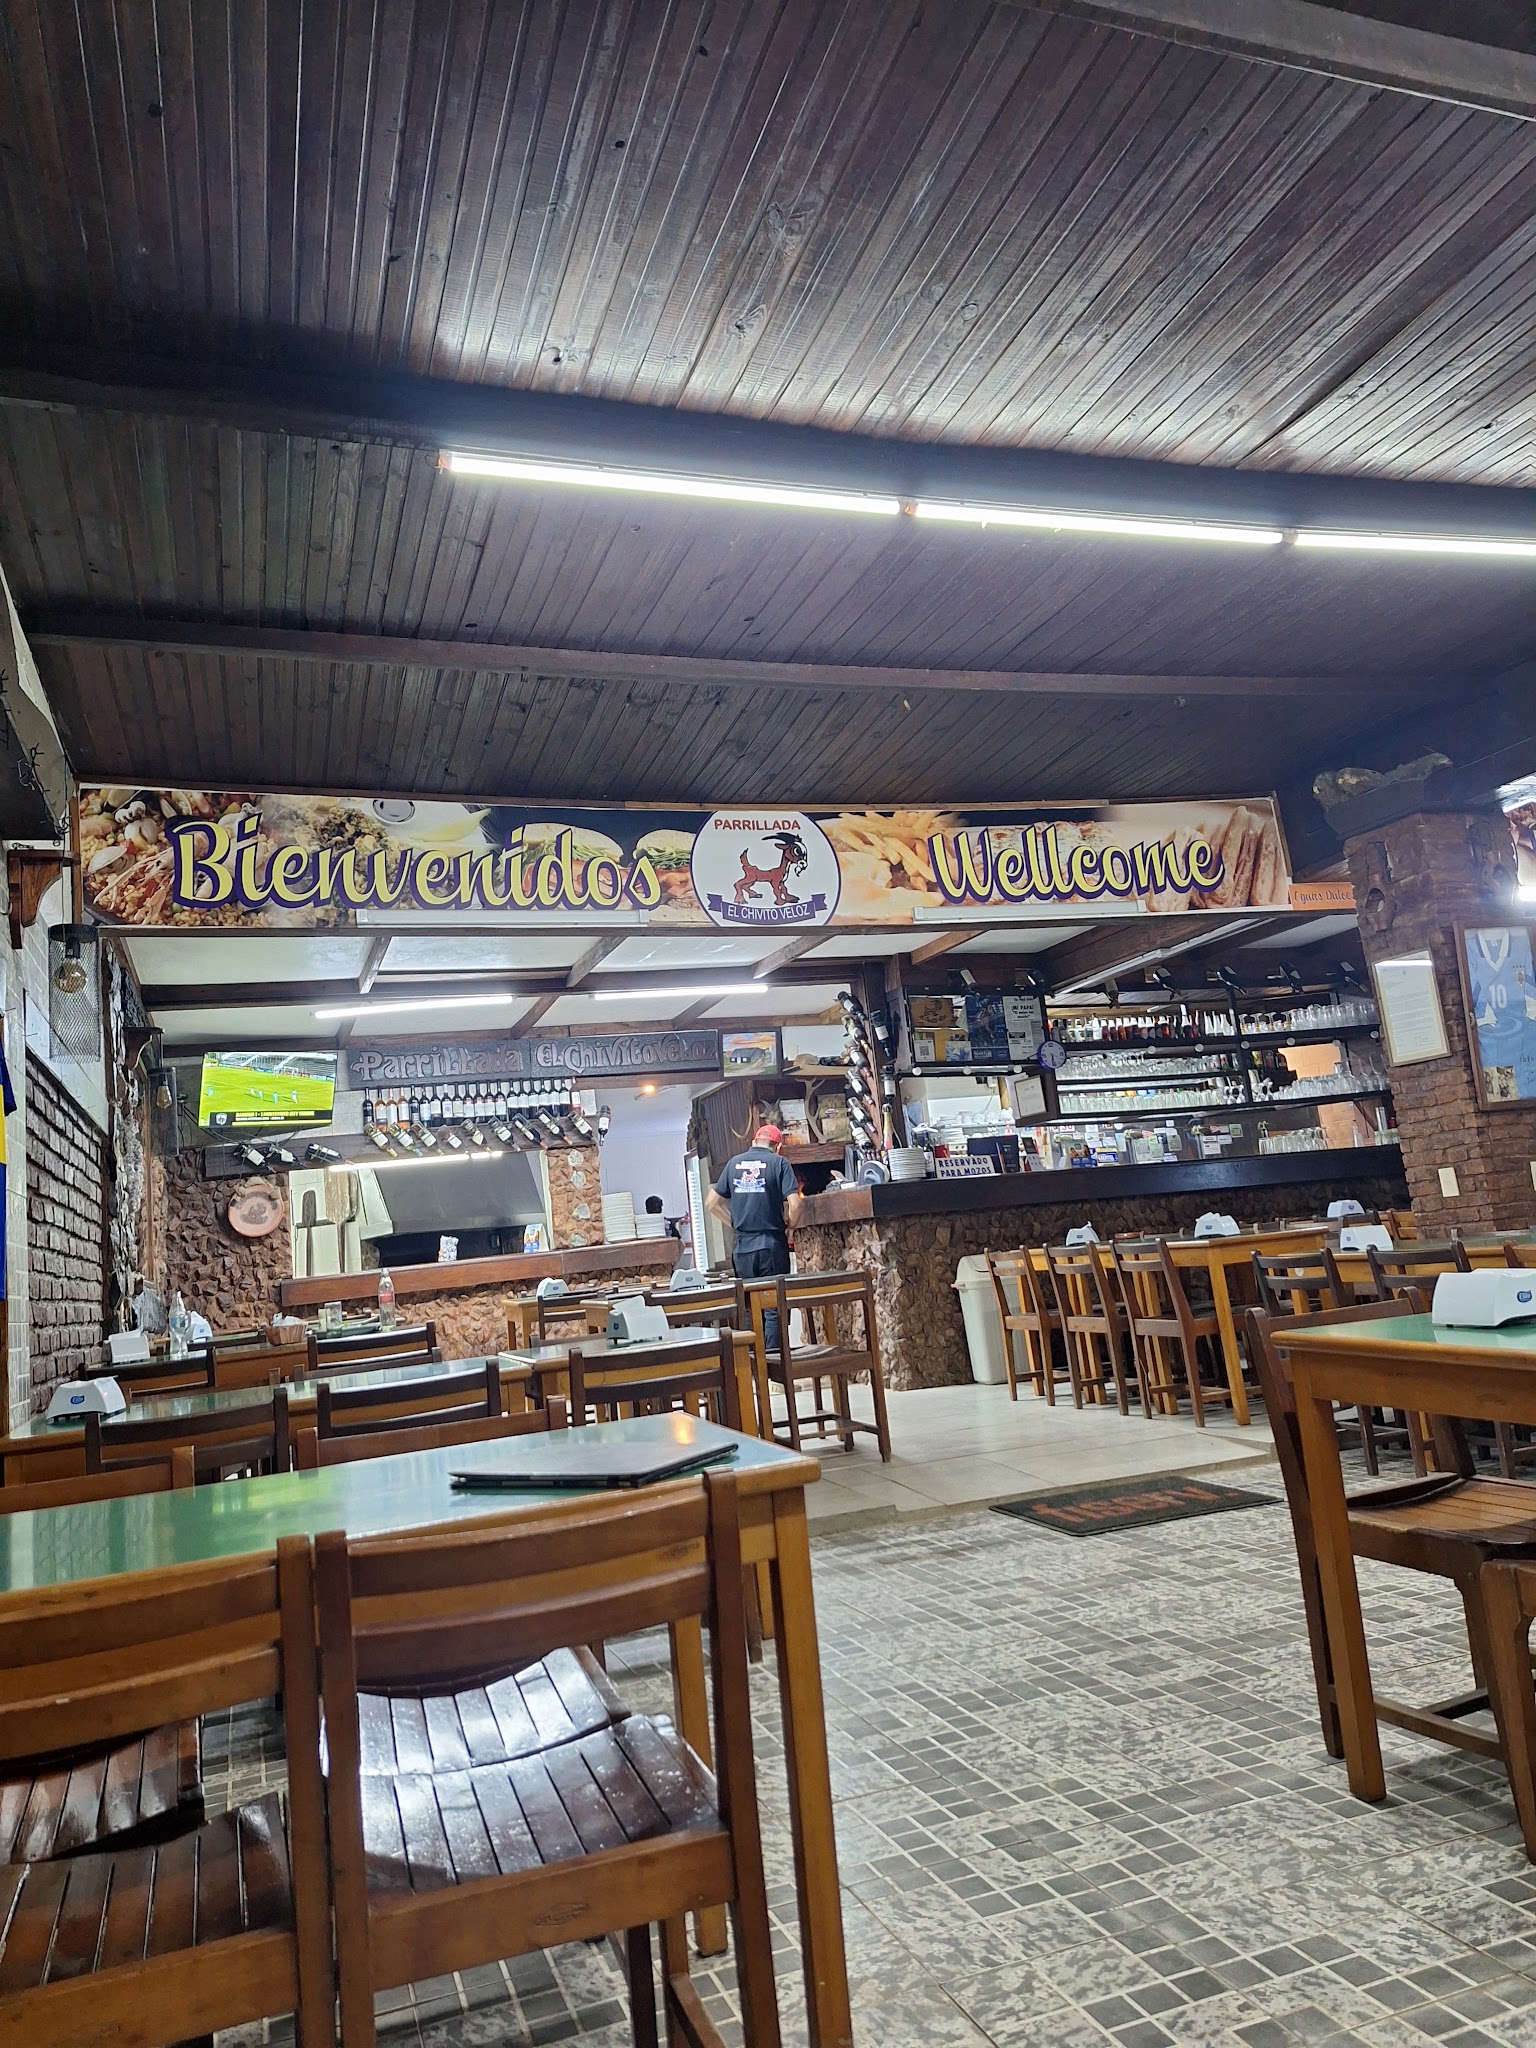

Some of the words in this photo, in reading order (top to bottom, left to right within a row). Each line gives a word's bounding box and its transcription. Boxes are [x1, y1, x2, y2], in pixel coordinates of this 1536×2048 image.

[714, 819, 801, 831] PARRILLADA
[166, 811, 661, 910] Bienvenidos
[928, 823, 1226, 905] Wellcome
[727, 904, 740, 918] EL
[741, 907, 779, 921] CHIVITO
[779, 903, 811, 921] VELOZ
[1488, 984, 1508, 1009] 10
[938, 1157, 988, 1168] RESERVADO
[940, 1169, 962, 1178] PARA
[963, 1166, 992, 1177] MOZOS
